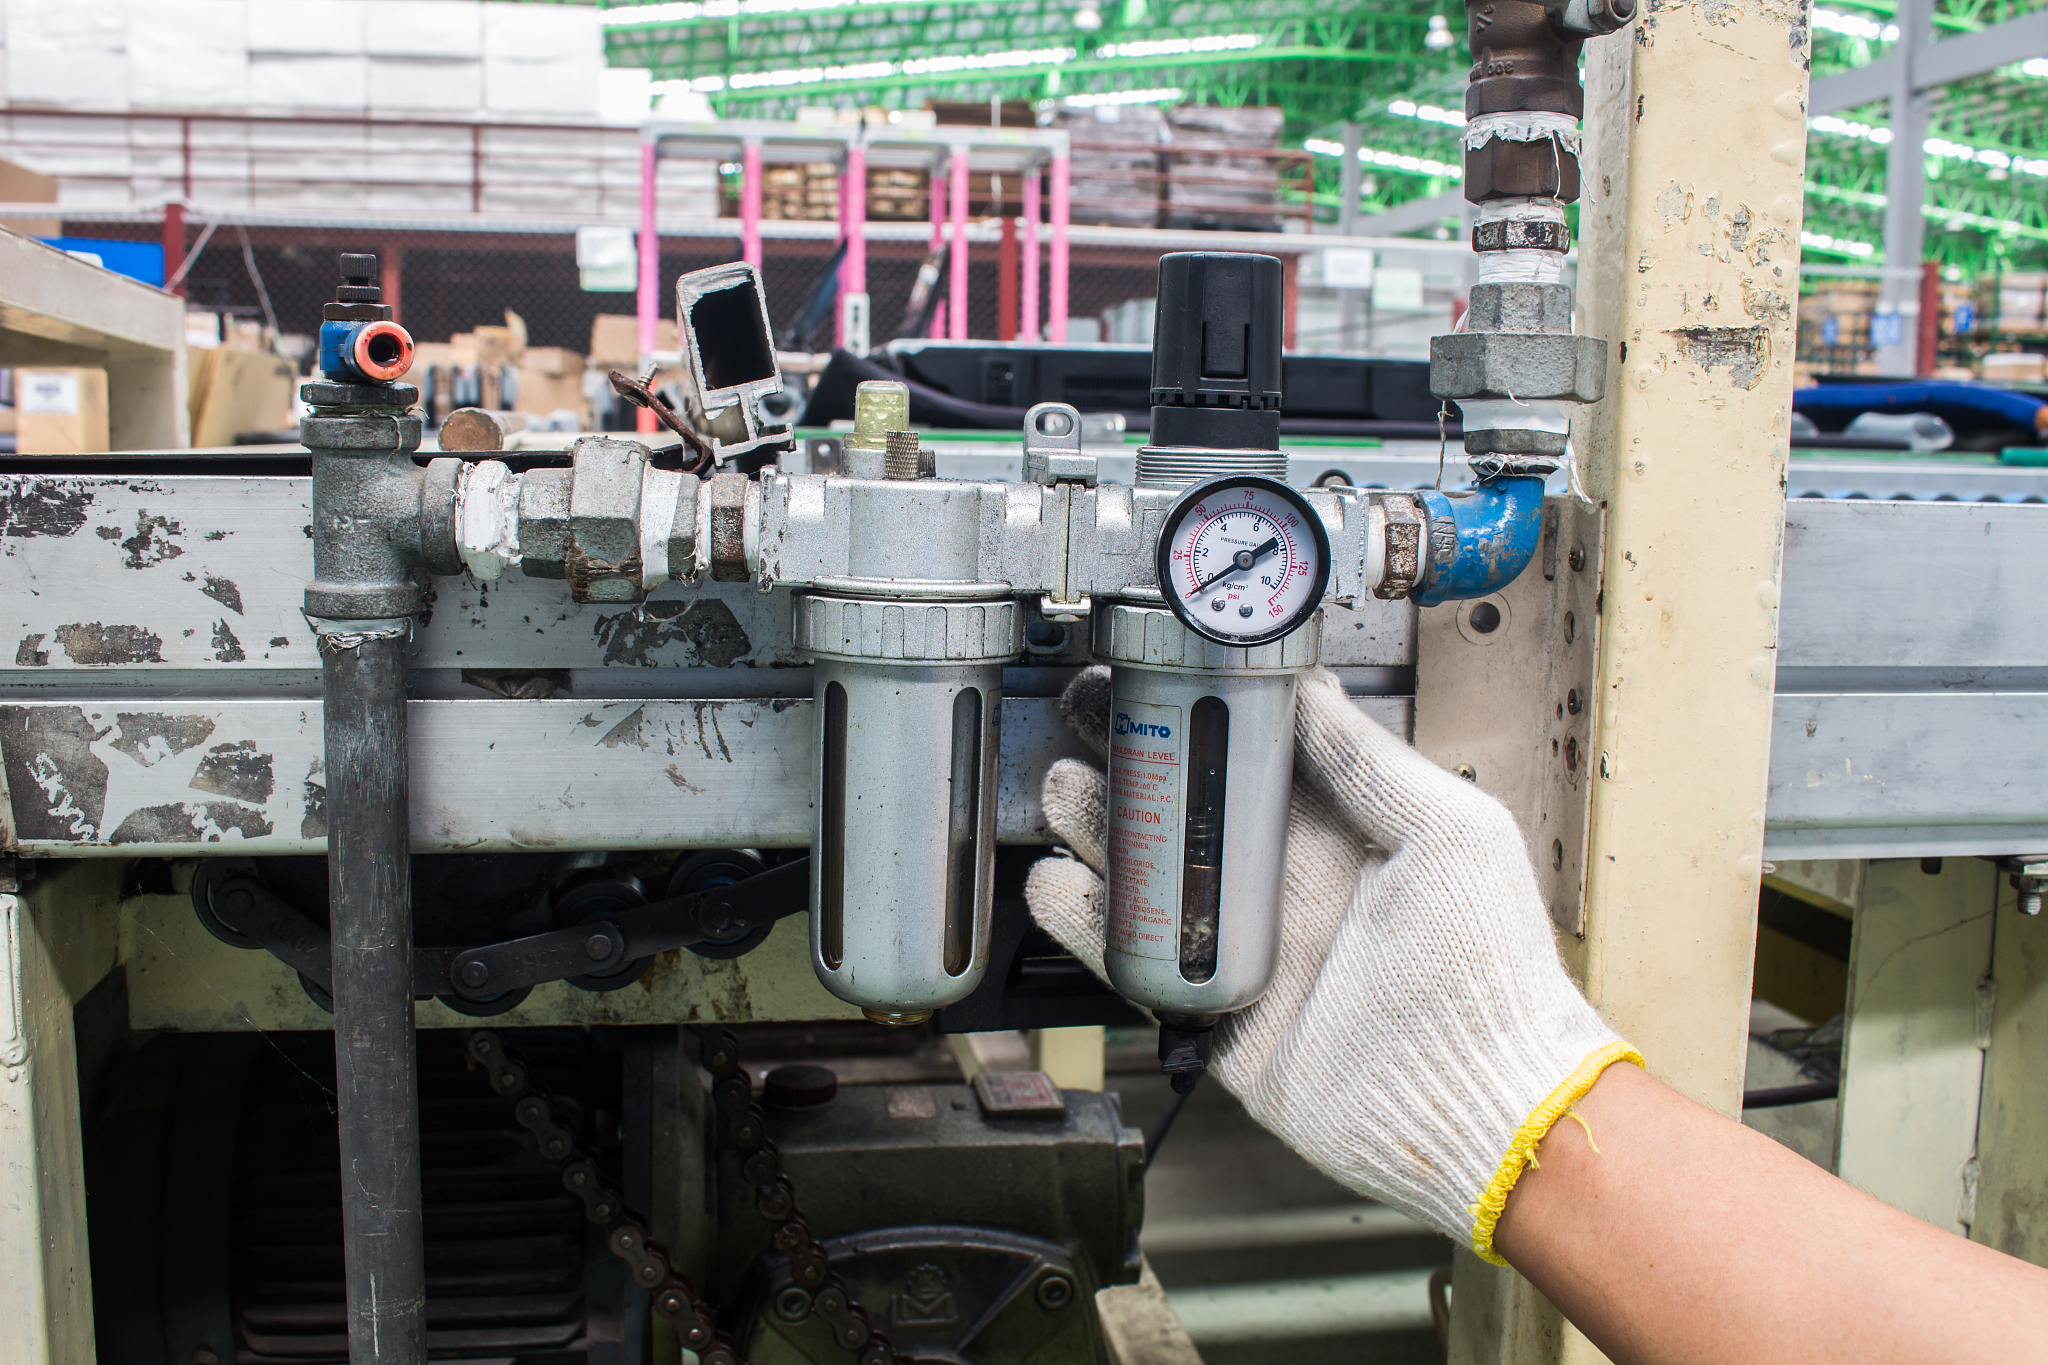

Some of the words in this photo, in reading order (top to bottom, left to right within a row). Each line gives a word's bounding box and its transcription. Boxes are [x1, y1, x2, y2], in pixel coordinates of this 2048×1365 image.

[1244, 491, 1254, 501] 75
[1194, 504, 1207, 517] 50
[1284, 512, 1299, 528] 100
[1220, 523, 1228, 532] 4
[1252, 523, 1260, 532] 6
[1220, 536, 1248, 547] PRESSURE
[1173, 550, 1183, 561] 25
[1202, 548, 1209, 557] 2
[1272, 546, 1279, 556] 8
[1297, 560, 1309, 576] 125
[1260, 576, 1271, 586] 10
[1227, 593, 1240, 601] psi
[1268, 604, 1284, 618] 150
[1130, 721, 1171, 738] MITO
[1147, 751, 1175, 761] LEVEL
[1160, 795, 1174, 803] P.C.
[1117, 805, 1161, 825] CAUTION
[1123, 829, 1167, 843] CONTACTING
[1122, 838, 1151, 851] THINNER,
[1125, 885, 1141, 895] ACID,
[1132, 896, 1151, 906] ACID,
[1129, 904, 1167, 917] KEROSENE,
[1118, 909, 1137, 920] OTHER
[1138, 914, 1172, 926] ORGANIC
[1138, 932, 1164, 943] DIRECT
